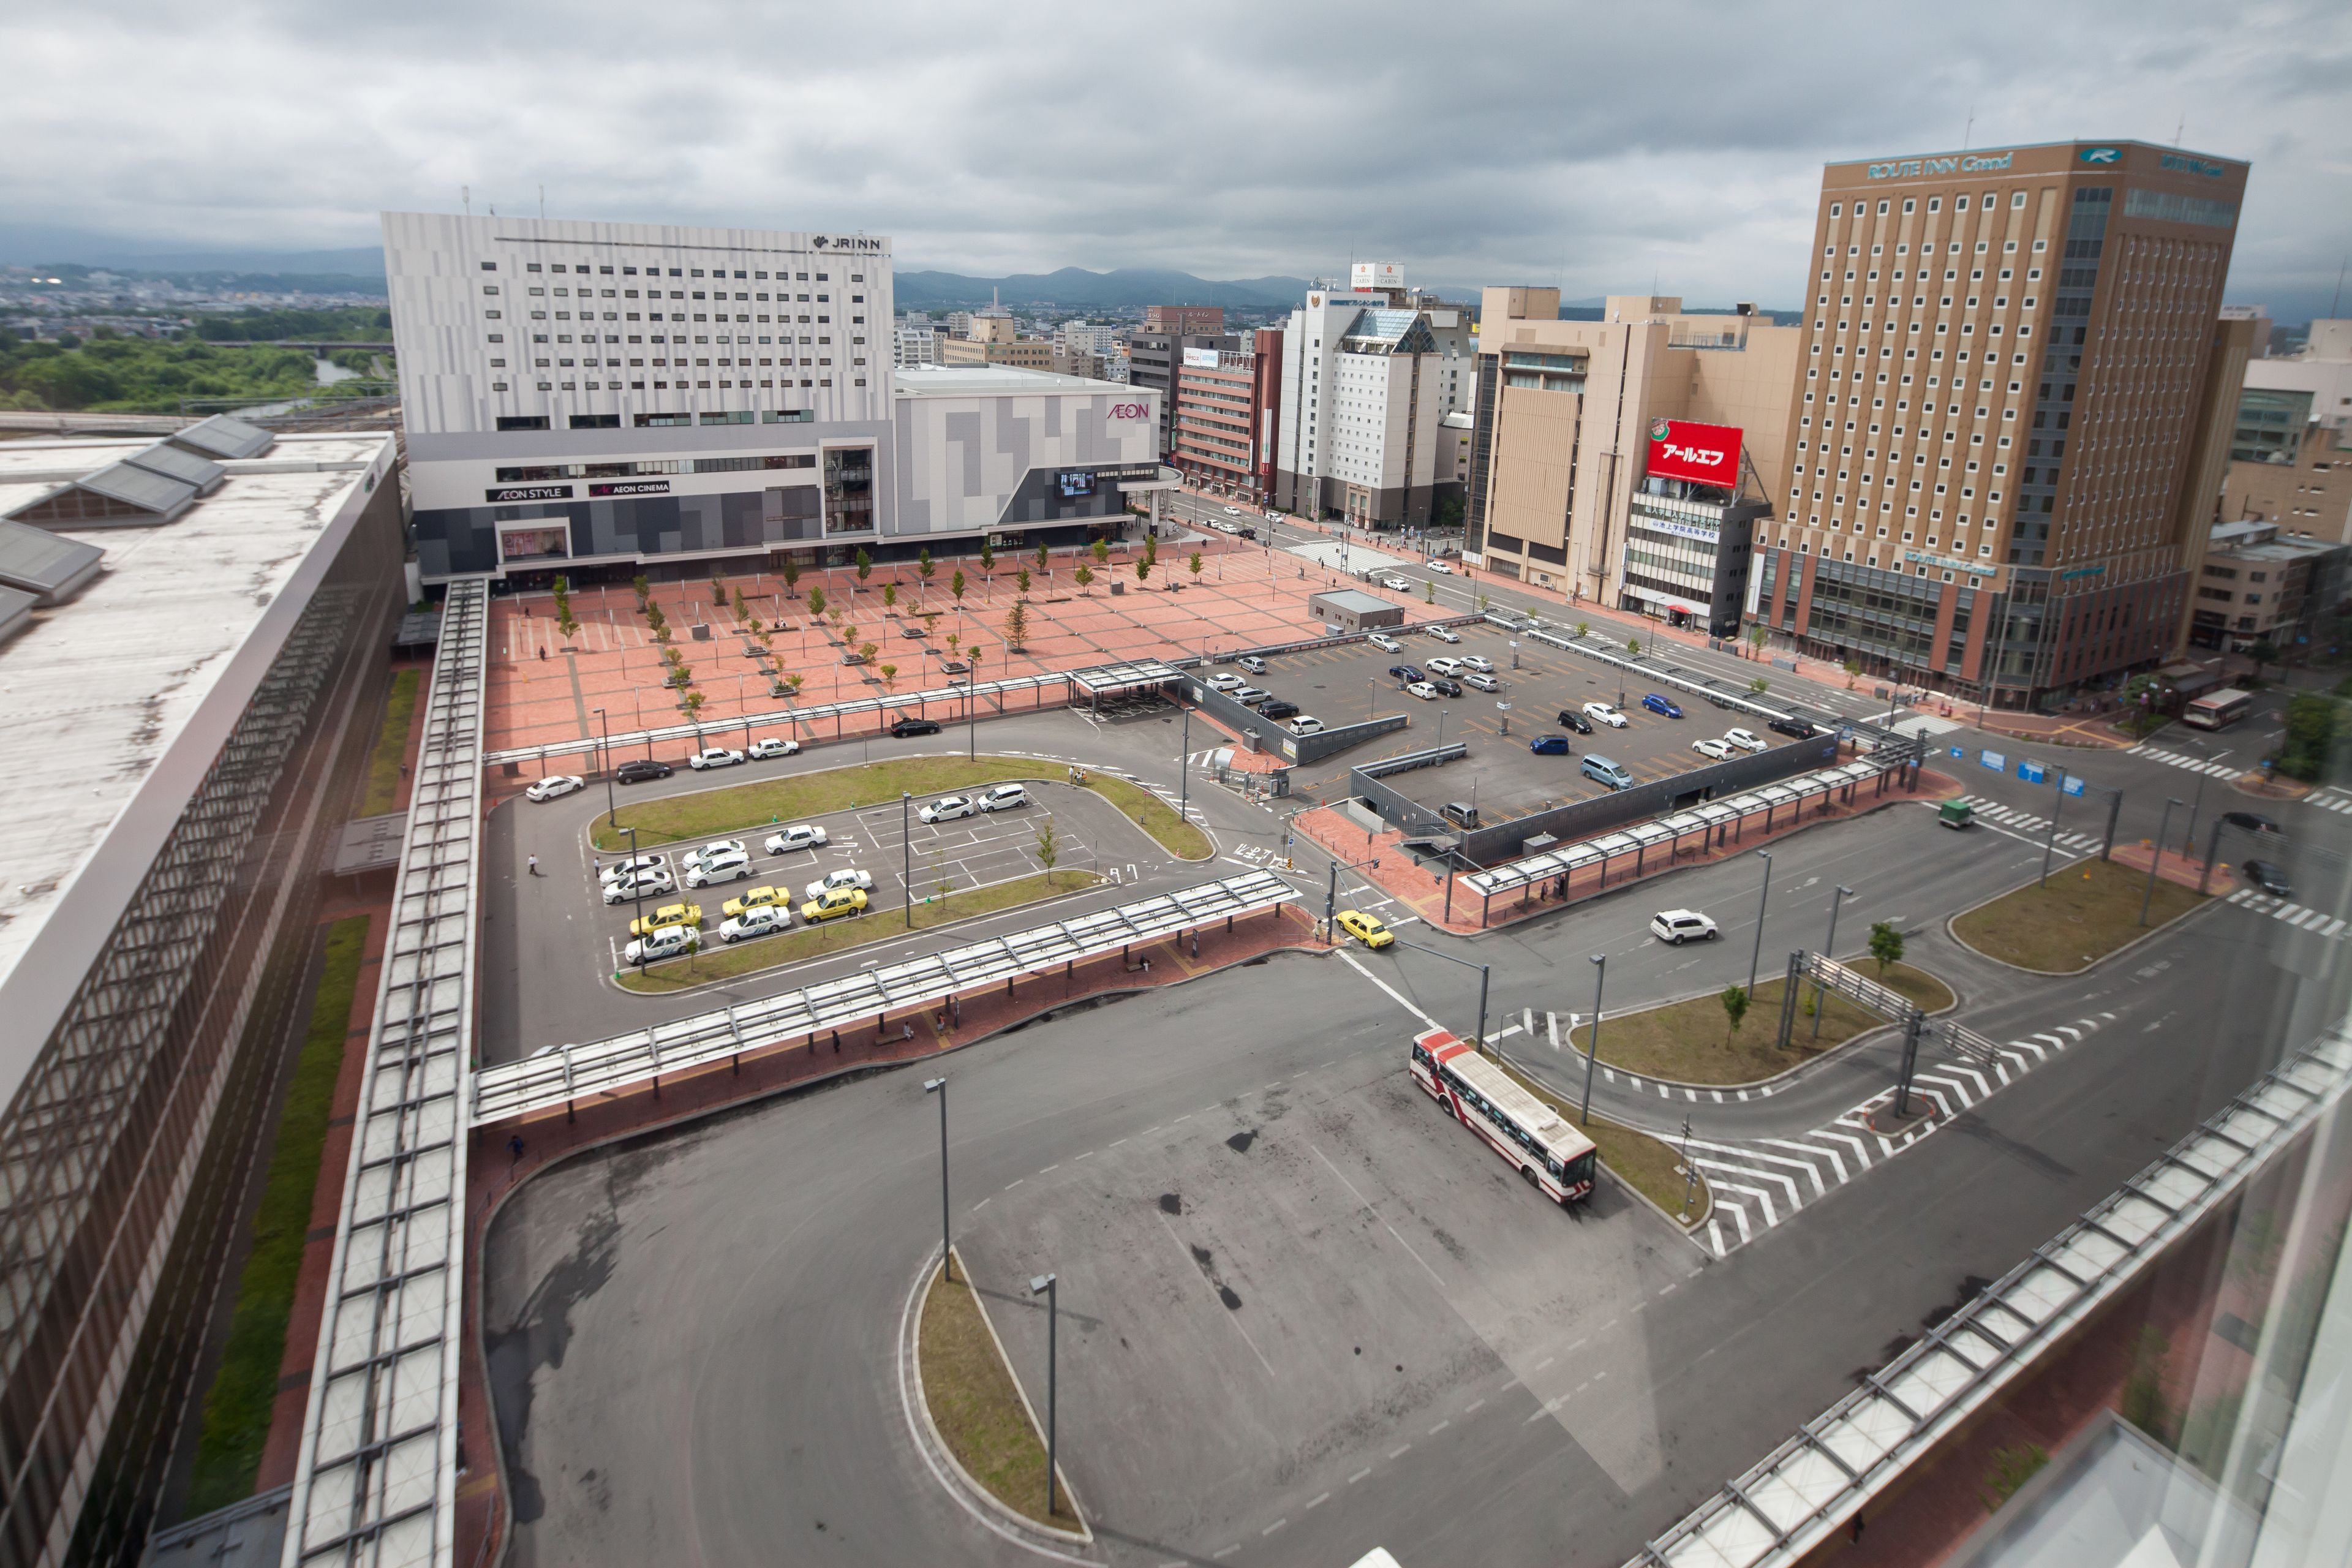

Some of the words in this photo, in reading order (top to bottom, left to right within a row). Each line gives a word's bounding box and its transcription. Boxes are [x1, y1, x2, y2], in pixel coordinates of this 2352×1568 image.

[1868, 160, 1922, 180] ROUTE
[1923, 157, 1959, 176] INN
[1961, 151, 2015, 172] Grand
[1662, 443, 1724, 466] アールエフ
[529, 488, 562, 500] STYLE
[613, 485, 636, 494] AEON
[638, 484, 669, 493] CINEMA
[1232, 843, 1274, 864] 止まれ
